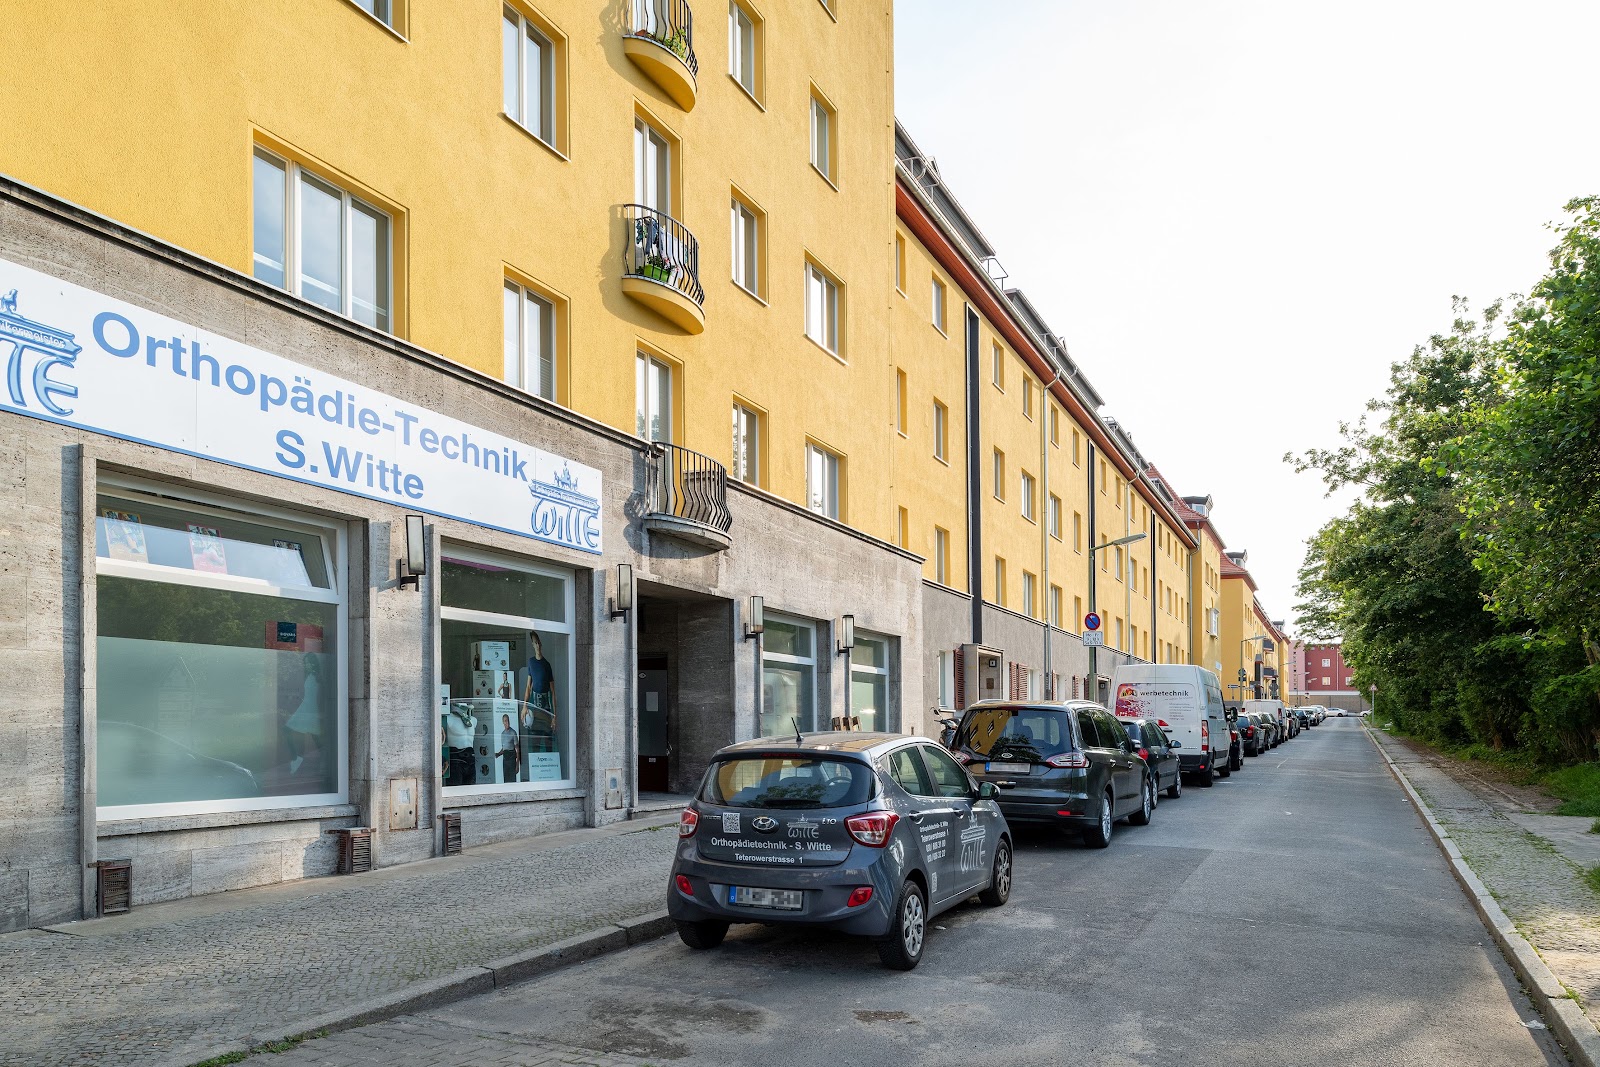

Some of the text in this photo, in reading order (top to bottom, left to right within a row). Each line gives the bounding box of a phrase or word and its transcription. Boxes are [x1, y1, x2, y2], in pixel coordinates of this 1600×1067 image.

[93, 312, 528, 482] Orthopädie-Technik
[711, 837, 787, 850] Orthopädietechnik
[795, 842, 805, 850] S.
[806, 842, 832, 851] Witte
[735, 853, 795, 864] Teterowerstrasse
